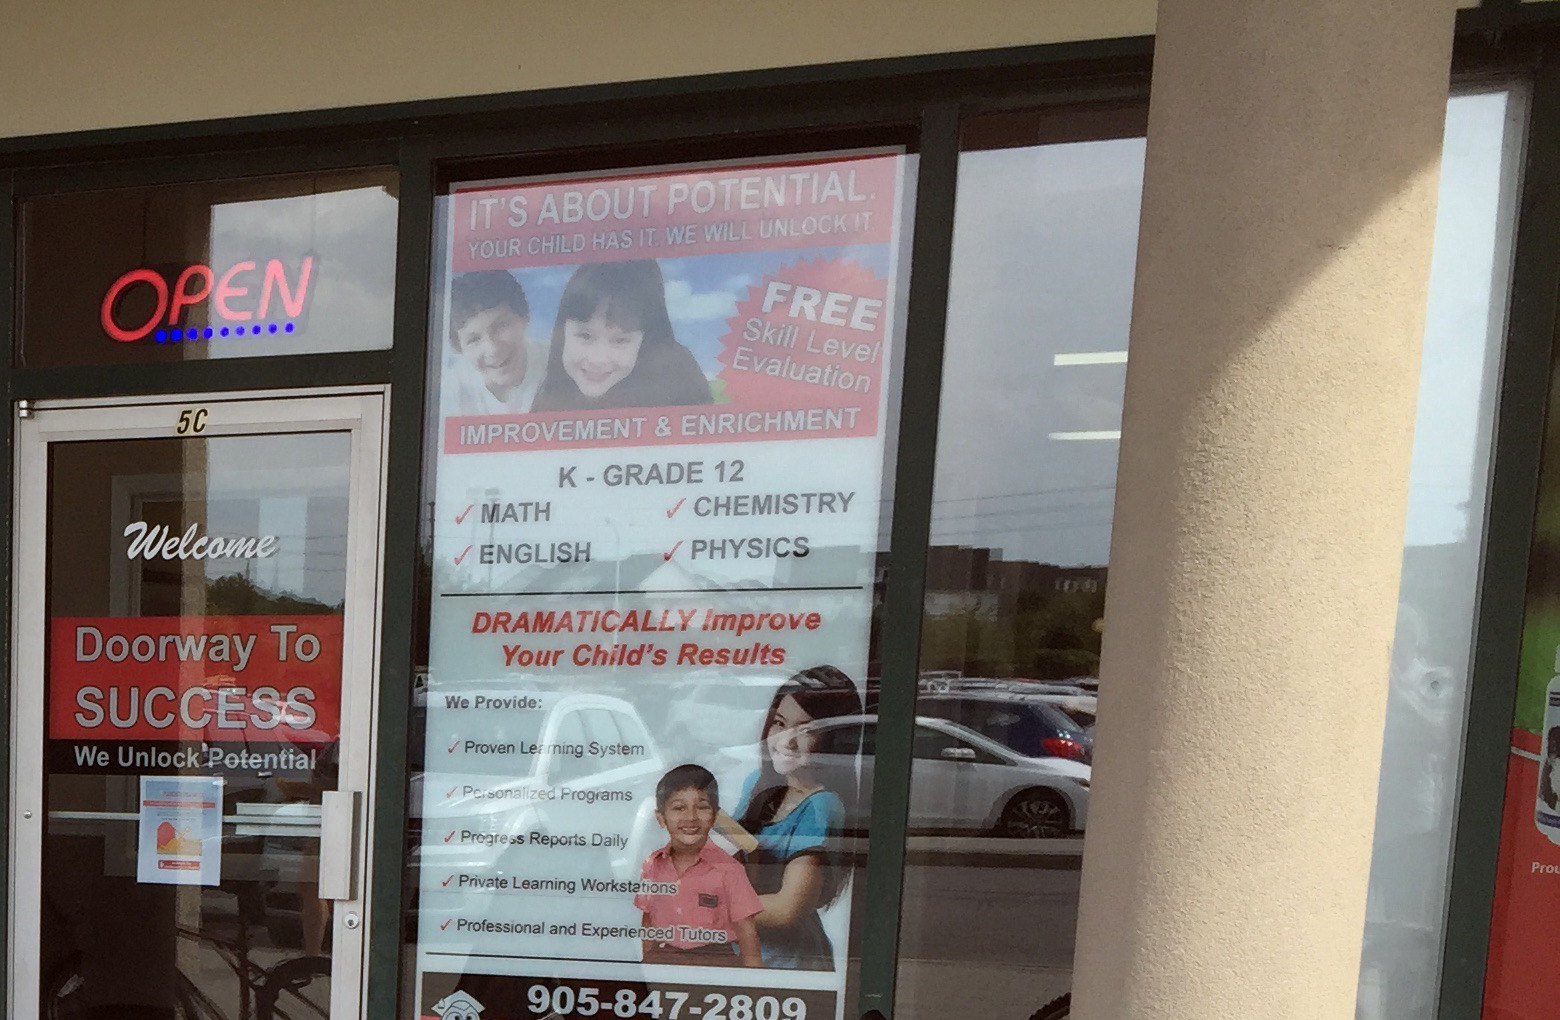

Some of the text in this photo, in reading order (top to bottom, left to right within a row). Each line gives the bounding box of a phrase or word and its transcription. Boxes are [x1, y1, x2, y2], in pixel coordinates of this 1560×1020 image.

[469, 169, 876, 231] IT'S ABOUT POTENTIAL.
[468, 238, 521, 260] YOUR
[527, 234, 586, 255] CHILD
[592, 230, 633, 251] HAS
[665, 225, 697, 245] WE
[704, 222, 752, 243] WILL
[759, 215, 847, 239] UNLOCK
[100, 256, 314, 343] OPEN
[761, 280, 883, 332] FREE
[743, 318, 883, 364] Skill Level
[732, 346, 872, 394] Evaluation
[176, 408, 208, 434] 5C
[460, 407, 862, 446] IMPROVEMENT & ENRICHMENT
[558, 466, 577, 489] K
[603, 462, 704, 488] GRADE
[715, 460, 745, 483] 12
[481, 491, 855, 524] MATH CHEMISTRY
[123, 521, 278, 561] Welcome
[479, 536, 810, 565] ENGLISH PHYSICS
[471, 608, 822, 636] DRAMATICALLY Improve
[74, 624, 322, 672] Doorway To
[501, 642, 786, 667] Your Child's Results
[73, 685, 317, 731] SUCCESS
[445, 695, 543, 710] We Provide:
[74, 745, 317, 770] We Unlock Potential
[464, 740, 645, 759] Proven Learning System
[462, 785, 633, 804] Personalized Programs
[460, 831, 629, 851] Progress Reports Daily
[1532, 861, 1560, 875] Prou
[458, 874, 679, 896] Private Learning Workstations
[456, 918, 727, 943] Professional and Experienced Tutors
